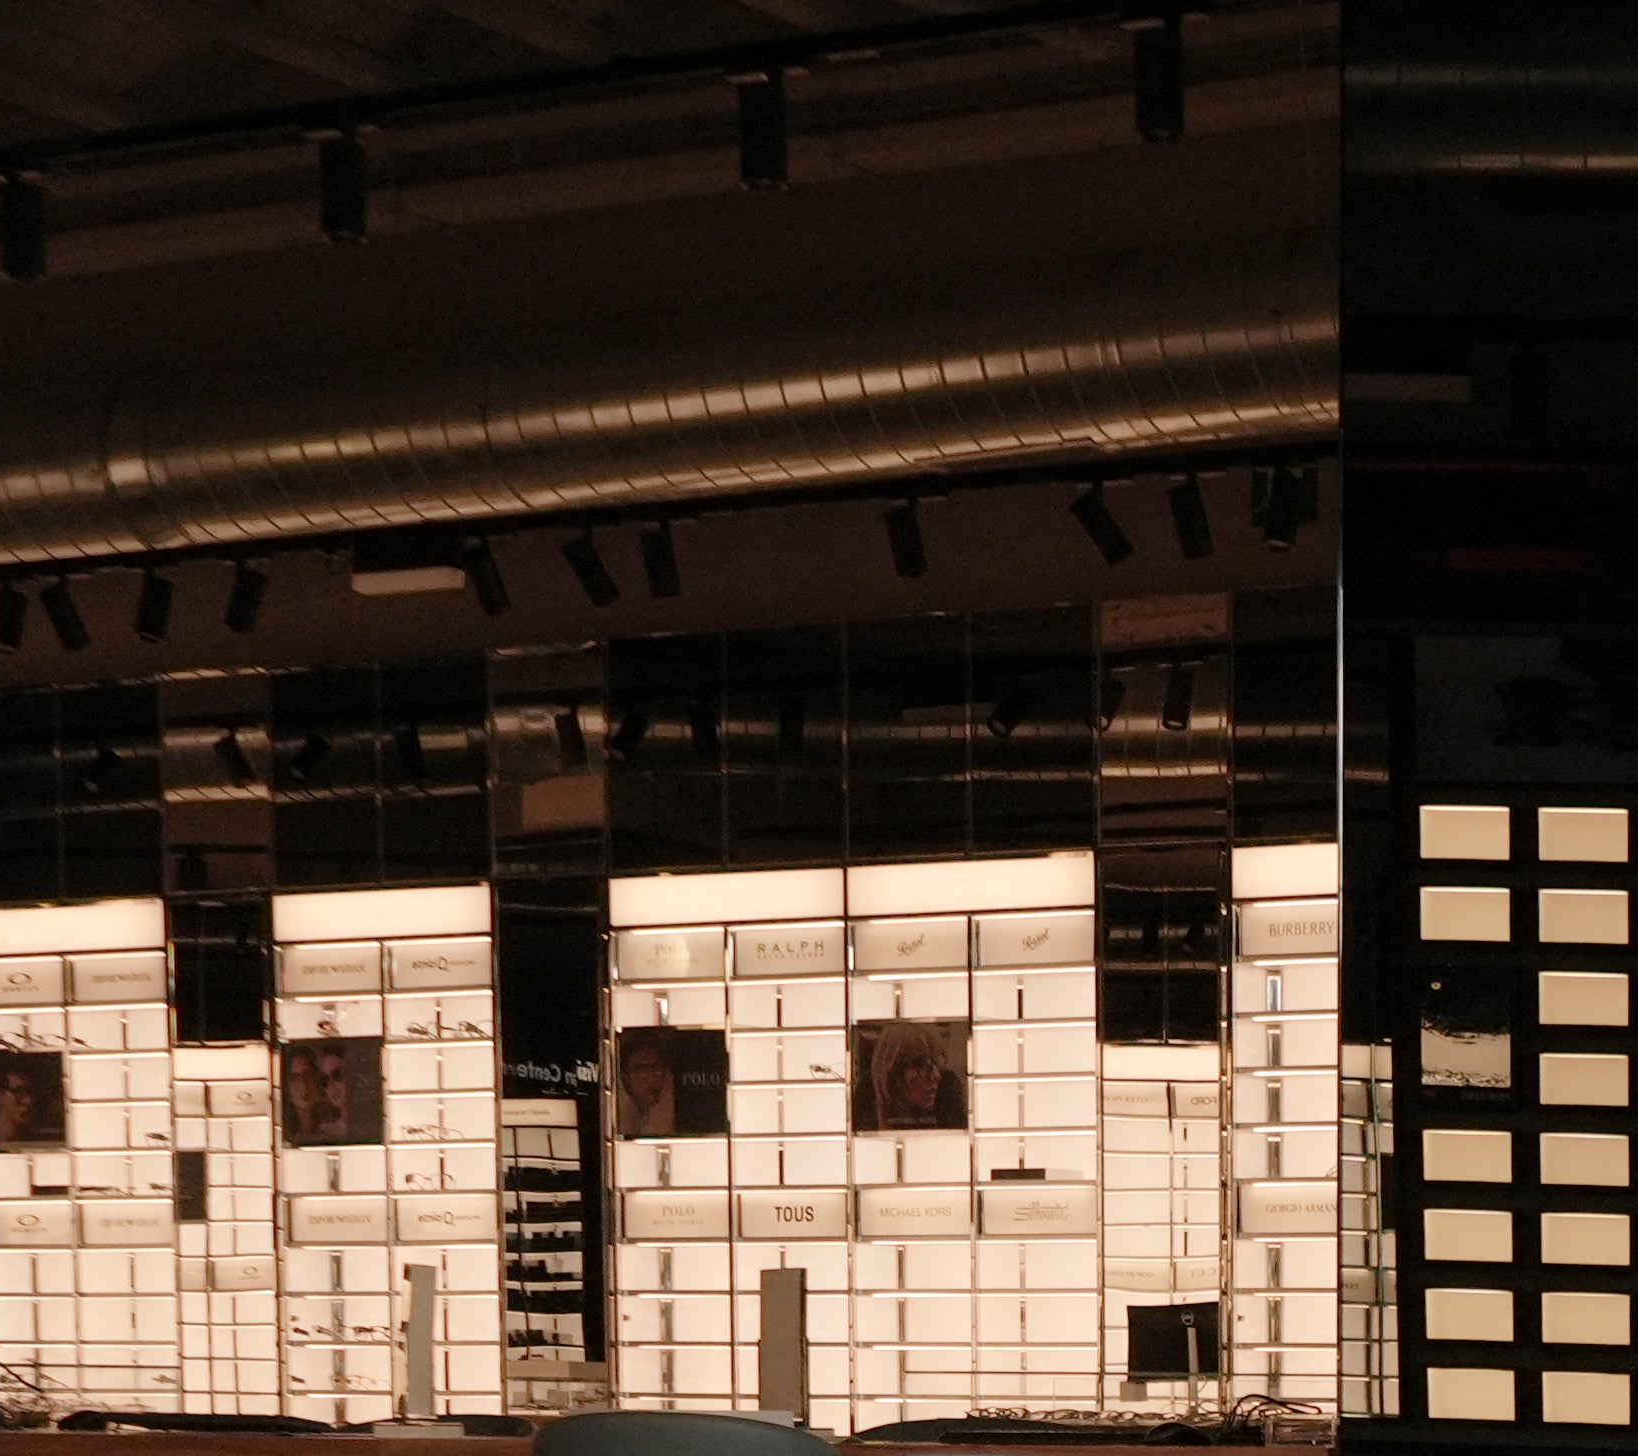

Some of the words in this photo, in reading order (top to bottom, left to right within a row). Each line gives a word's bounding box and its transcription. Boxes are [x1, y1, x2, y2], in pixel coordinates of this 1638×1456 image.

[1269, 921, 1335, 937] BURBERRY
[757, 941, 825, 953] RALPH
[661, 1206, 695, 1218] POLO
[774, 1206, 814, 1222] TOUS
[880, 1207, 923, 1218] MICHAEL
[925, 1206, 952, 1217] KORS
[1266, 1204, 1302, 1214] GIORGIO
[1304, 1203, 1338, 1213] ARMAN
